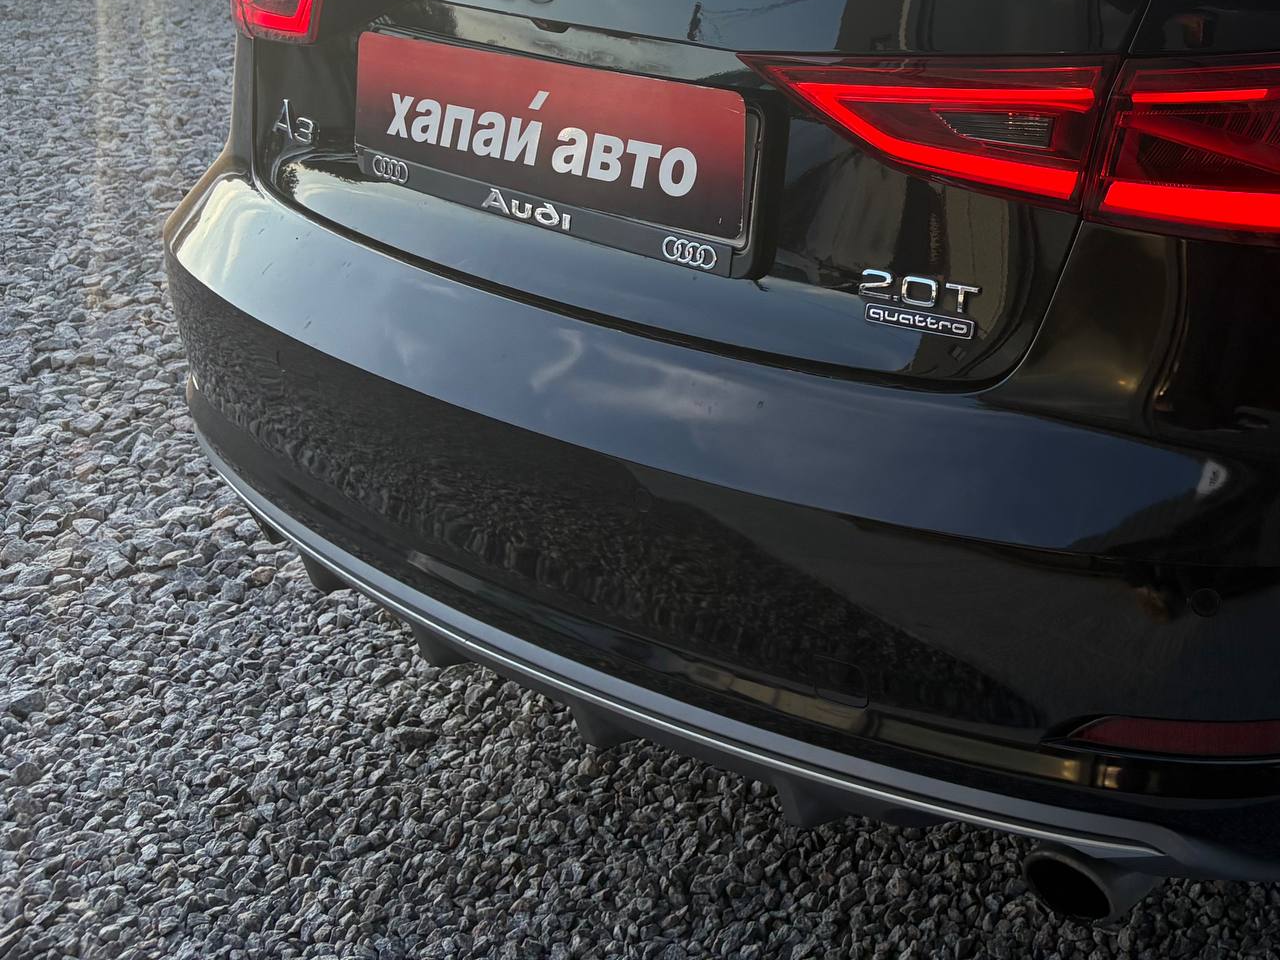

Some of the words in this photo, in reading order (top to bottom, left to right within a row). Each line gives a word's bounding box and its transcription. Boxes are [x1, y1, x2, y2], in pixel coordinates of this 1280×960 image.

[271, 98, 314, 144] A3
[551, 127, 698, 197] авто
[480, 188, 572, 231] Audi
[858, 268, 981, 313] 2.0T
[869, 307, 968, 335] quattro
